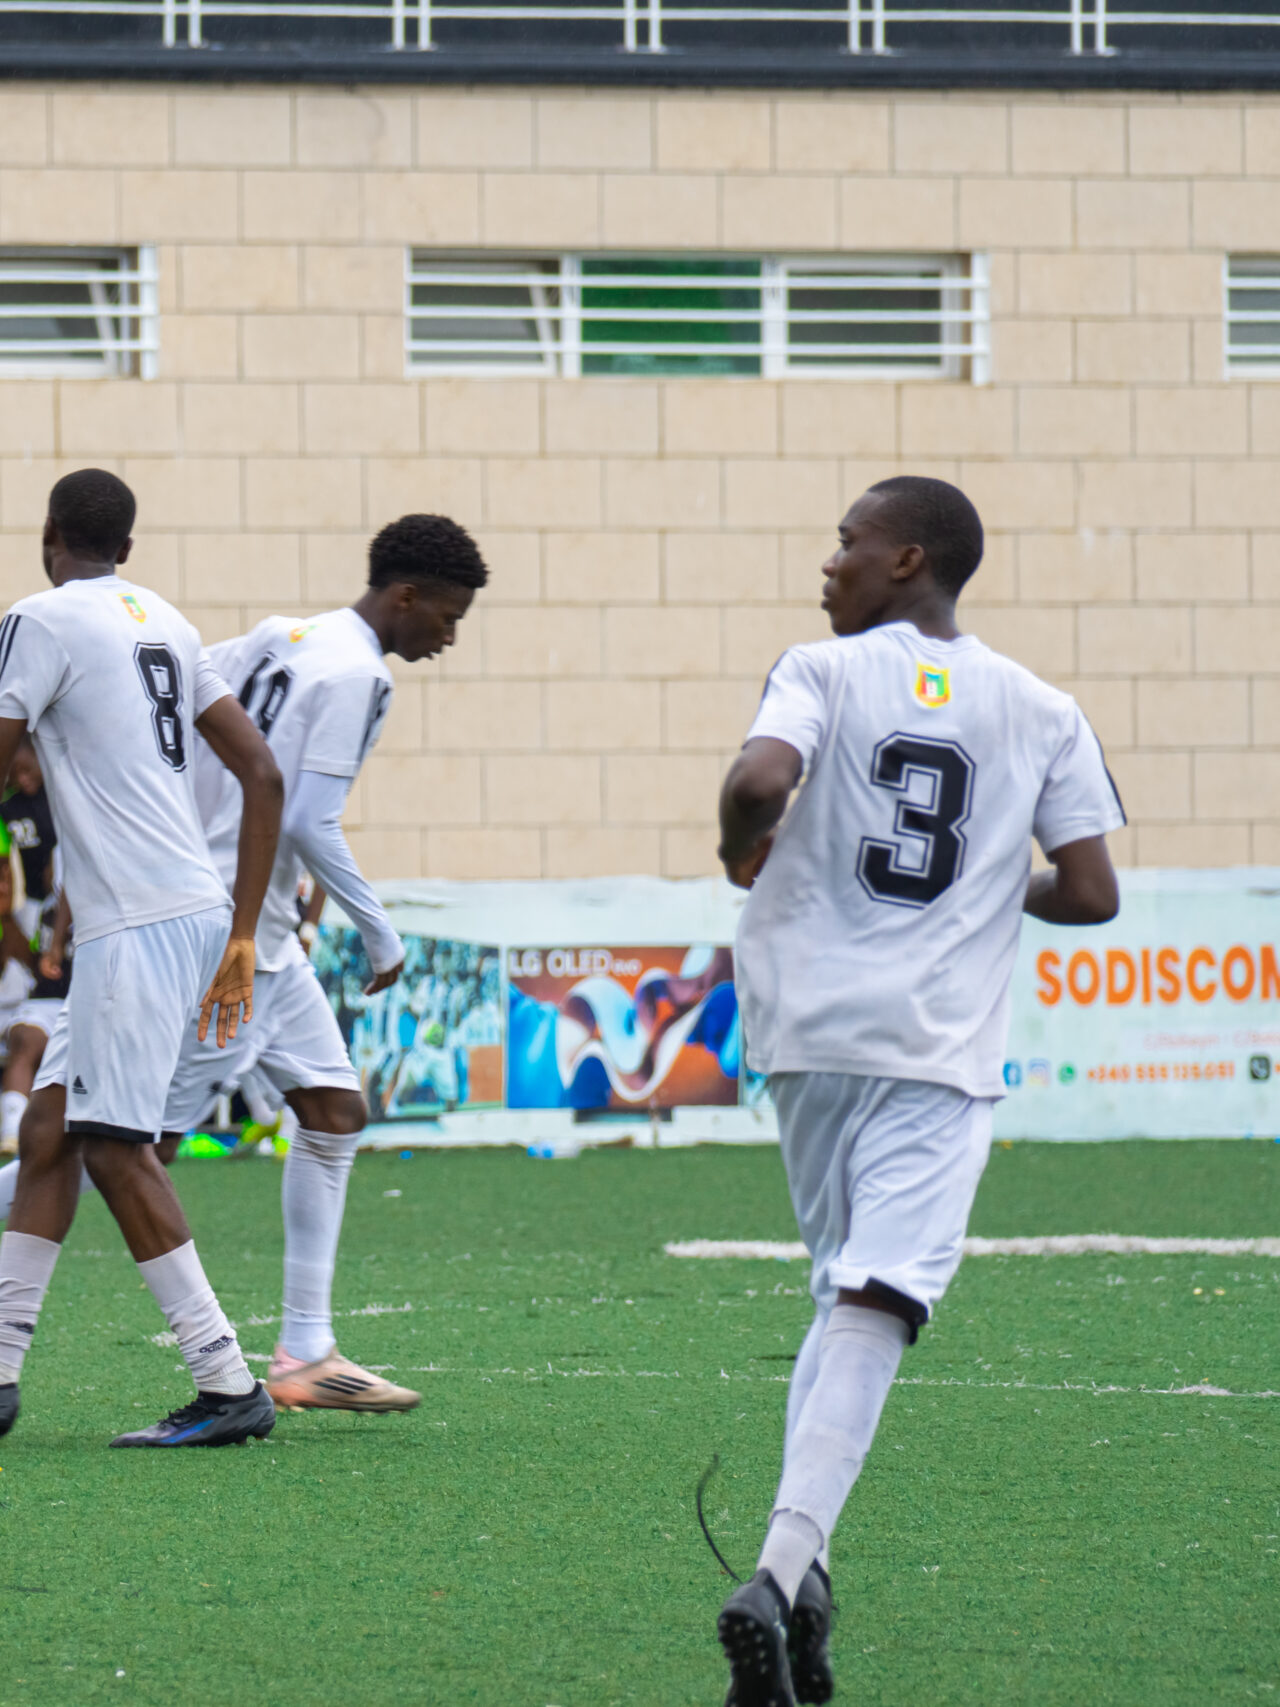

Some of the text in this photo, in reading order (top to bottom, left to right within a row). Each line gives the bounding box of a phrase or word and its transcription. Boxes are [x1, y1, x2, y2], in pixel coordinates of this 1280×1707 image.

[133, 642, 187, 773] 8
[856, 731, 976, 910] 3
[510, 949, 542, 976] LG
[547, 949, 613, 976] OLED
